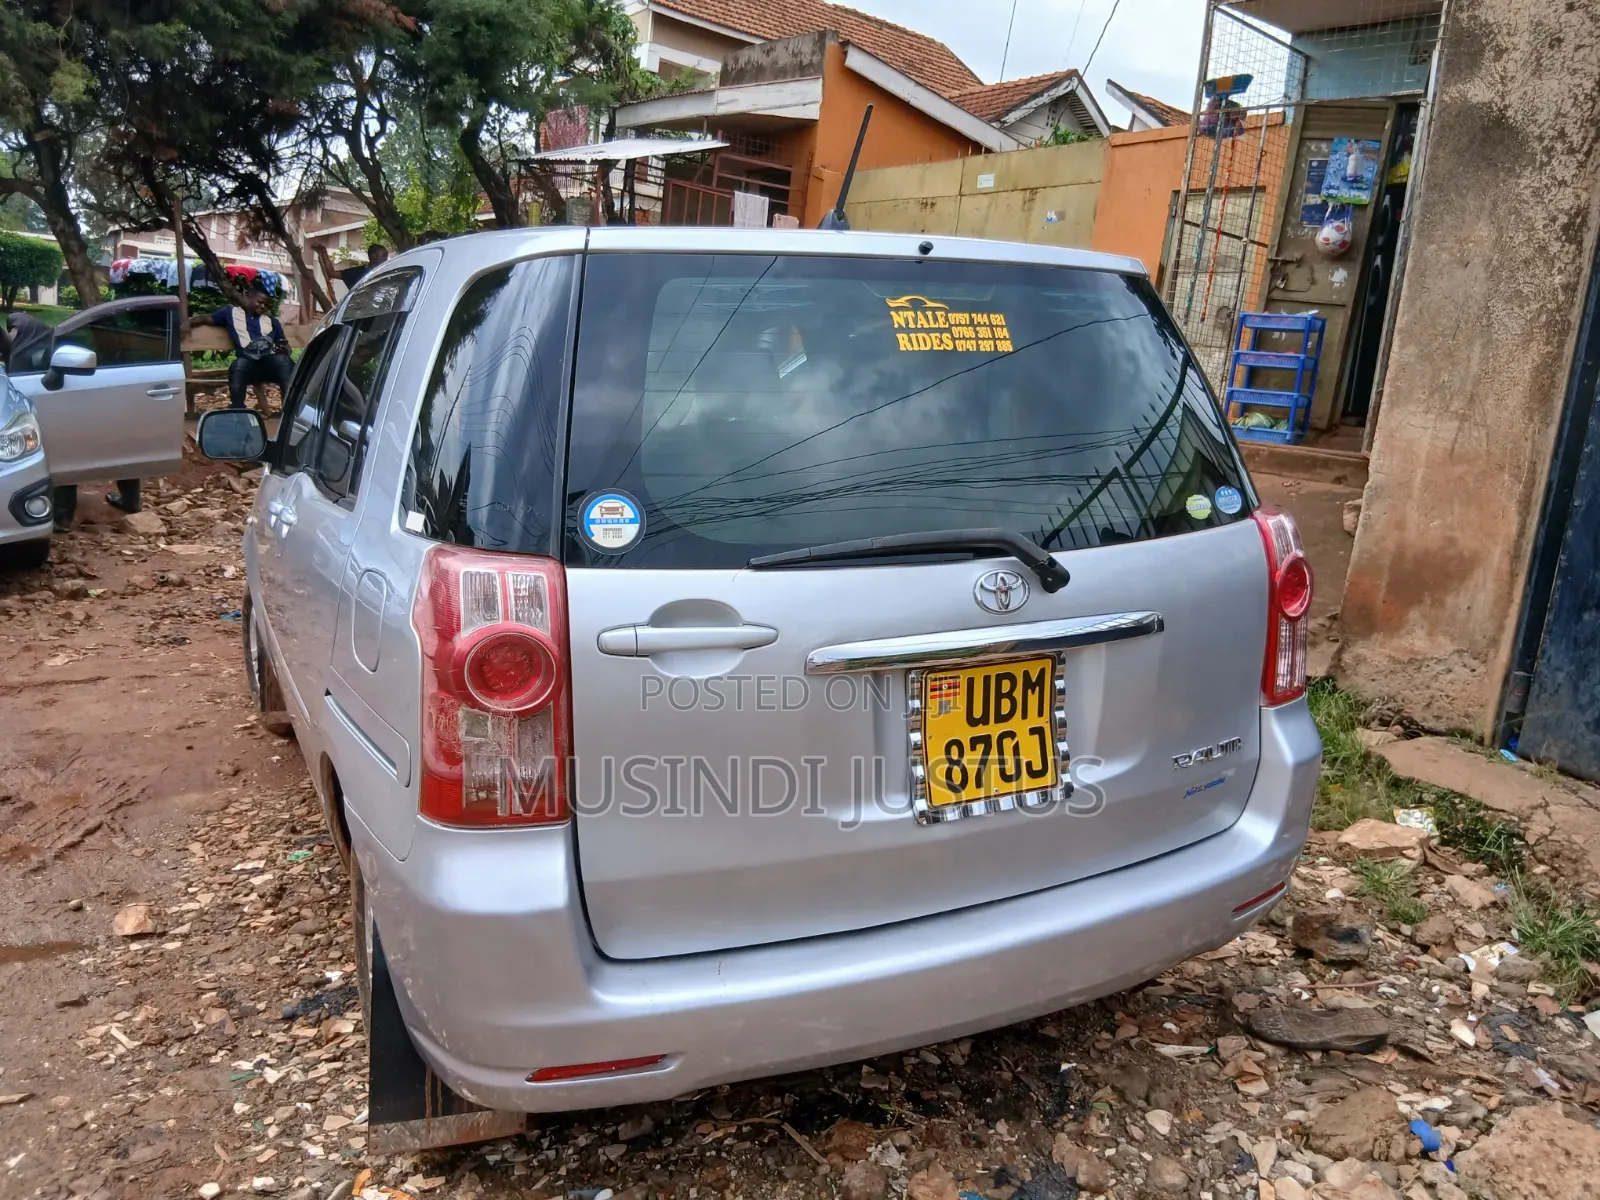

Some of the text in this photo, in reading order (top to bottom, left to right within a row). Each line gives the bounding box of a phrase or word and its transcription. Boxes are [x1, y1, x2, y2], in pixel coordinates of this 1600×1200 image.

[890, 311, 949, 329] NTALE
[948, 313, 970, 325] 0757
[971, 313, 990, 326] 744
[951, 326, 976, 339] 0766
[976, 327, 993, 339] 351
[896, 333, 954, 351] RIDES
[955, 339, 977, 352] 0747
[965, 667, 1046, 728] UBM
[944, 726, 1049, 794] 870J
